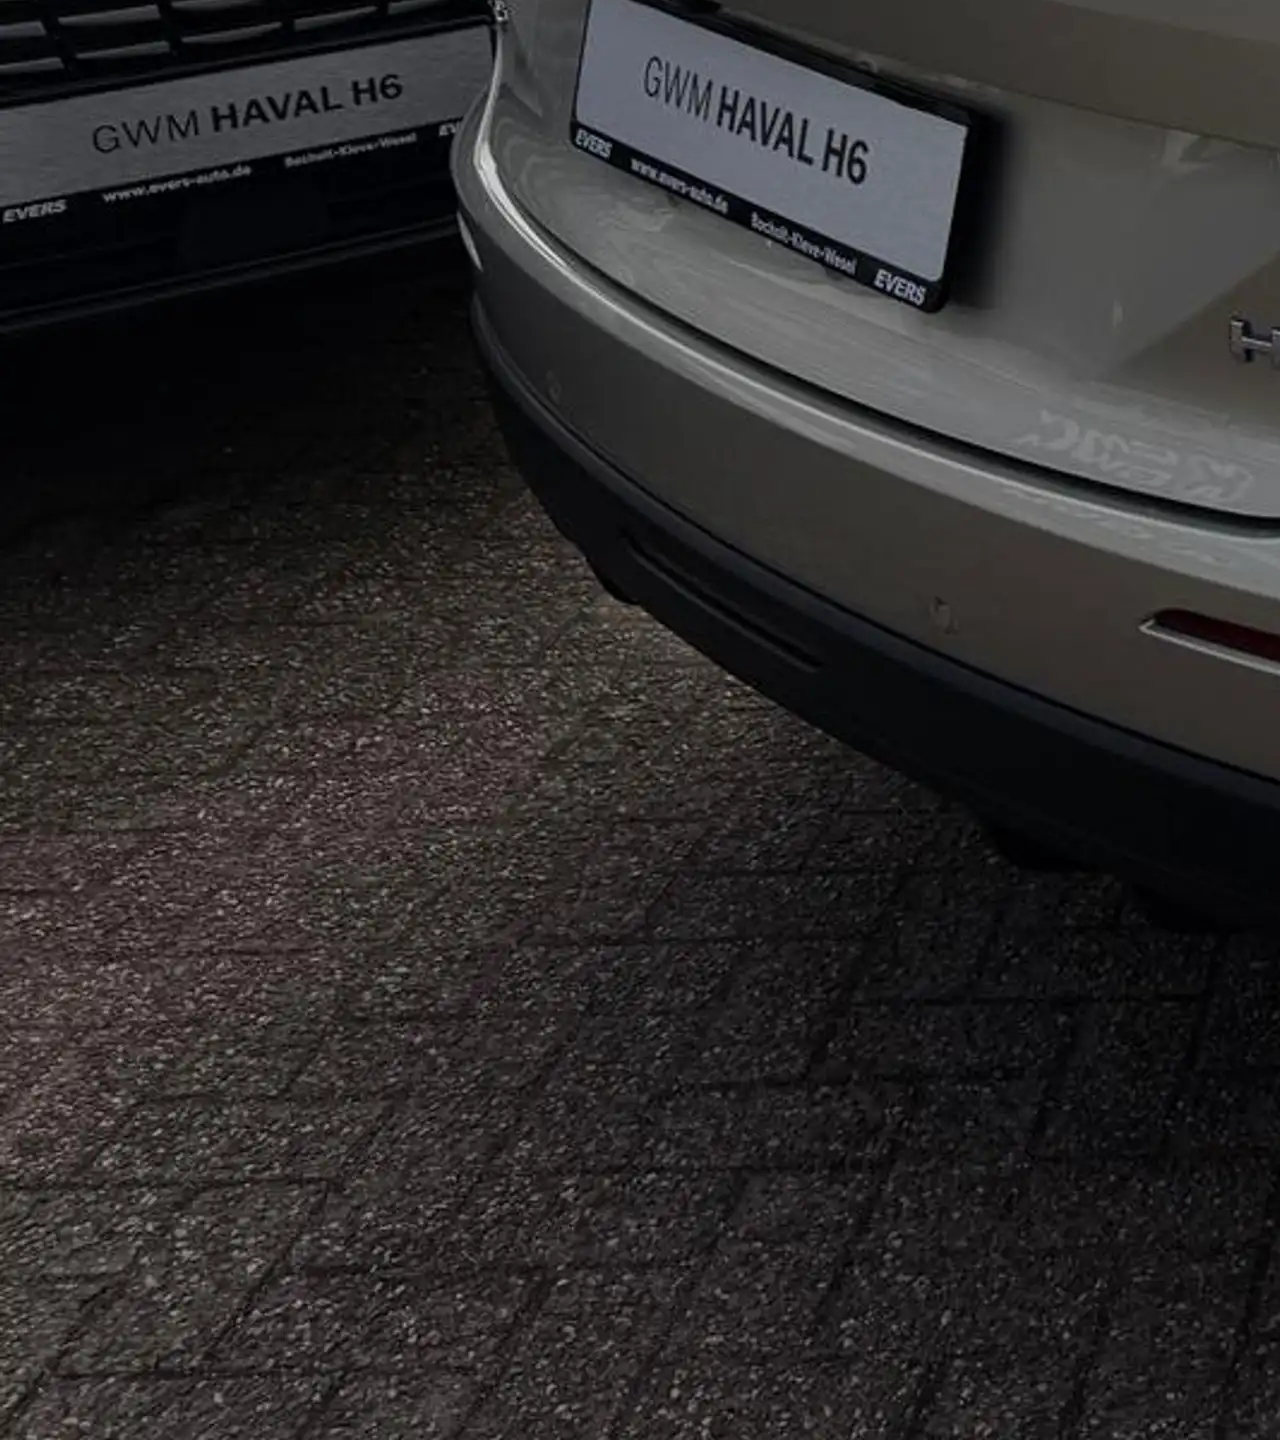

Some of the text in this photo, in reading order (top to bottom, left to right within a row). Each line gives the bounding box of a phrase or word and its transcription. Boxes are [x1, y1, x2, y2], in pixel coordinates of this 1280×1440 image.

[92, 74, 403, 154] GWM HAVAL H6
[643, 55, 869, 186] GWM HAVAL H6
[2, 198, 67, 224] EVERS
[575, 129, 613, 160] EVERS
[873, 268, 927, 306] EVERS
